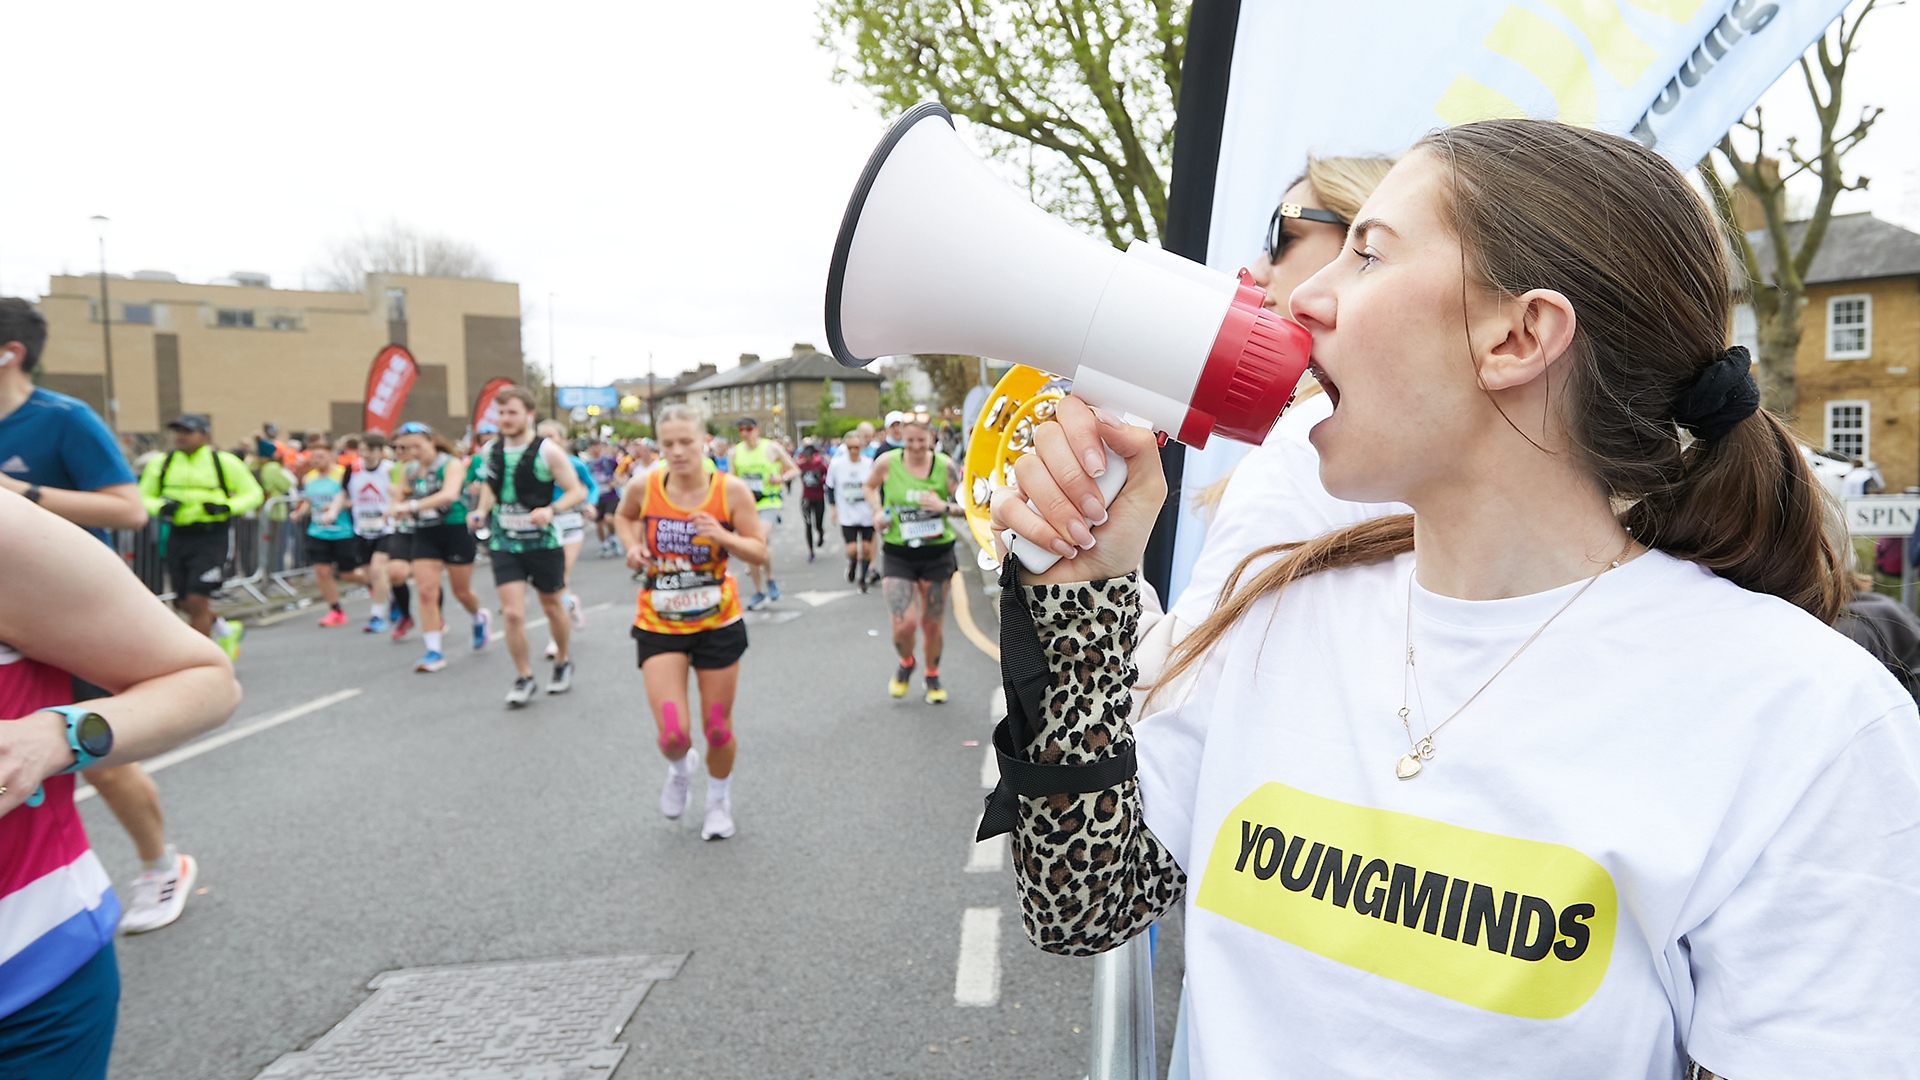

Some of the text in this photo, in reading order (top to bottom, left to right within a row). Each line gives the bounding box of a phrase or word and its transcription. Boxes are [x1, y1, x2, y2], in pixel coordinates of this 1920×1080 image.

[656, 530, 690, 543] WITH
[656, 542, 711, 555] CANCER
[662, 590, 711, 611] 26015
[1234, 820, 1596, 962] YOUNGMINDS
